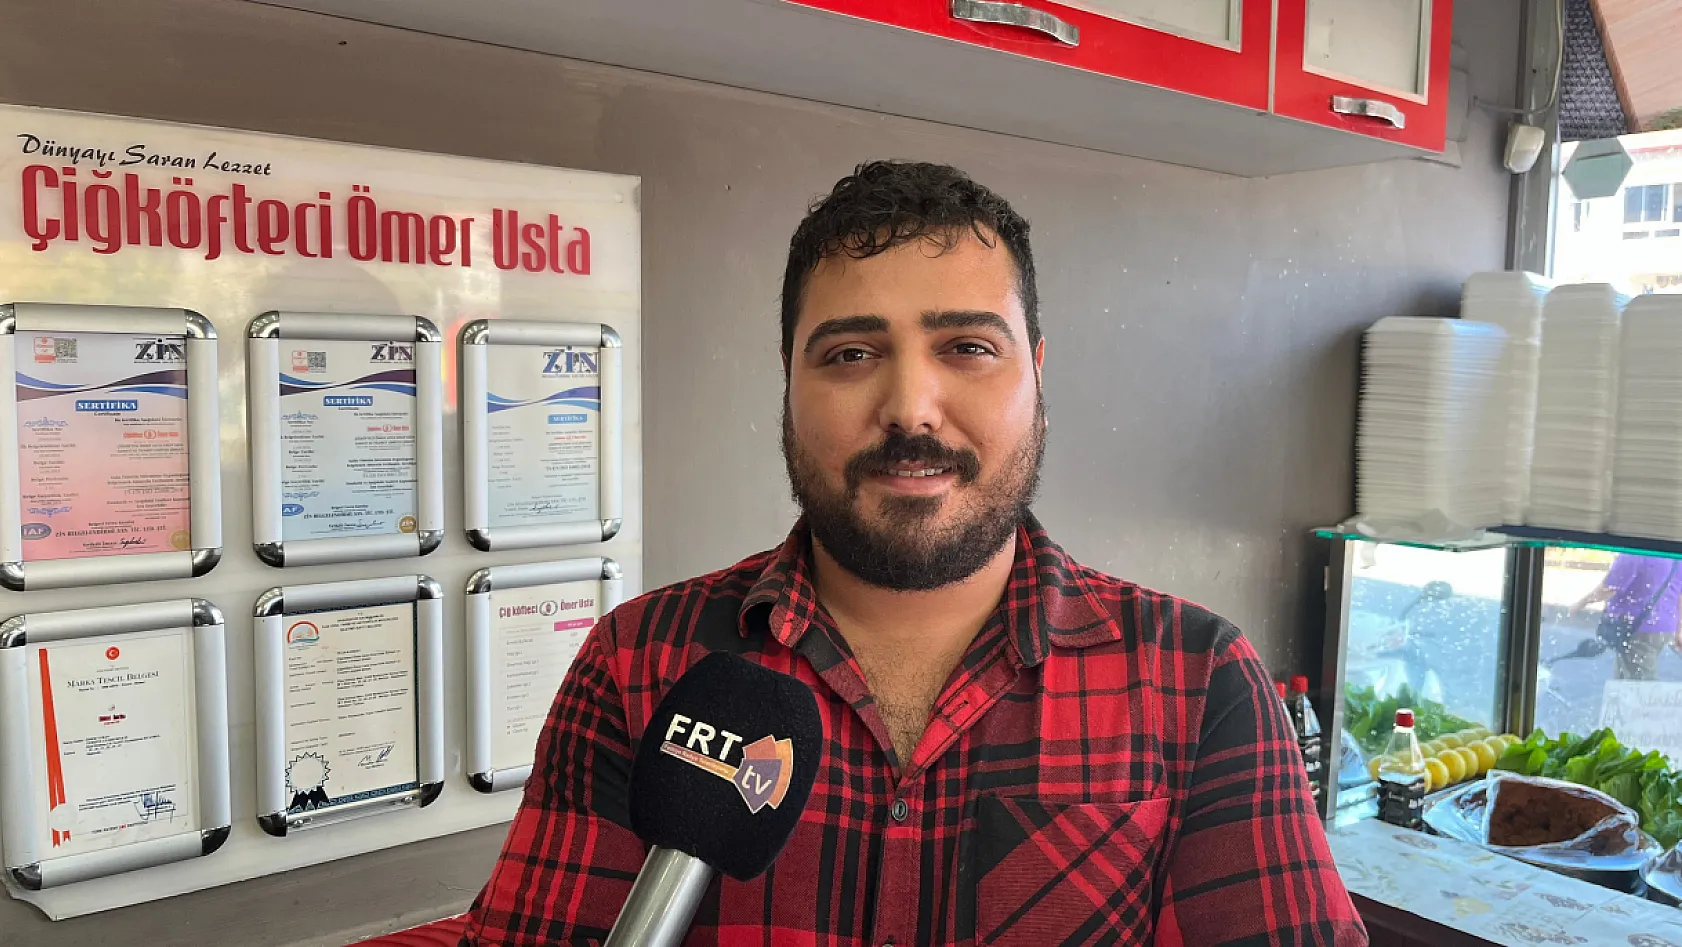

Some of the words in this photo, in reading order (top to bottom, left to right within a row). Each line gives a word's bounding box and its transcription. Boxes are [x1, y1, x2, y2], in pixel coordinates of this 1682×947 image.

[17, 133, 116, 167] Dünyayı
[119, 143, 196, 169] Saran
[203, 151, 272, 176] Lezzet
[21, 164, 333, 261] Çiğköfteci
[347, 184, 475, 267] Ömer
[492, 207, 591, 276] Usta
[665, 713, 743, 761] FRT
[741, 765, 773, 795] tv
